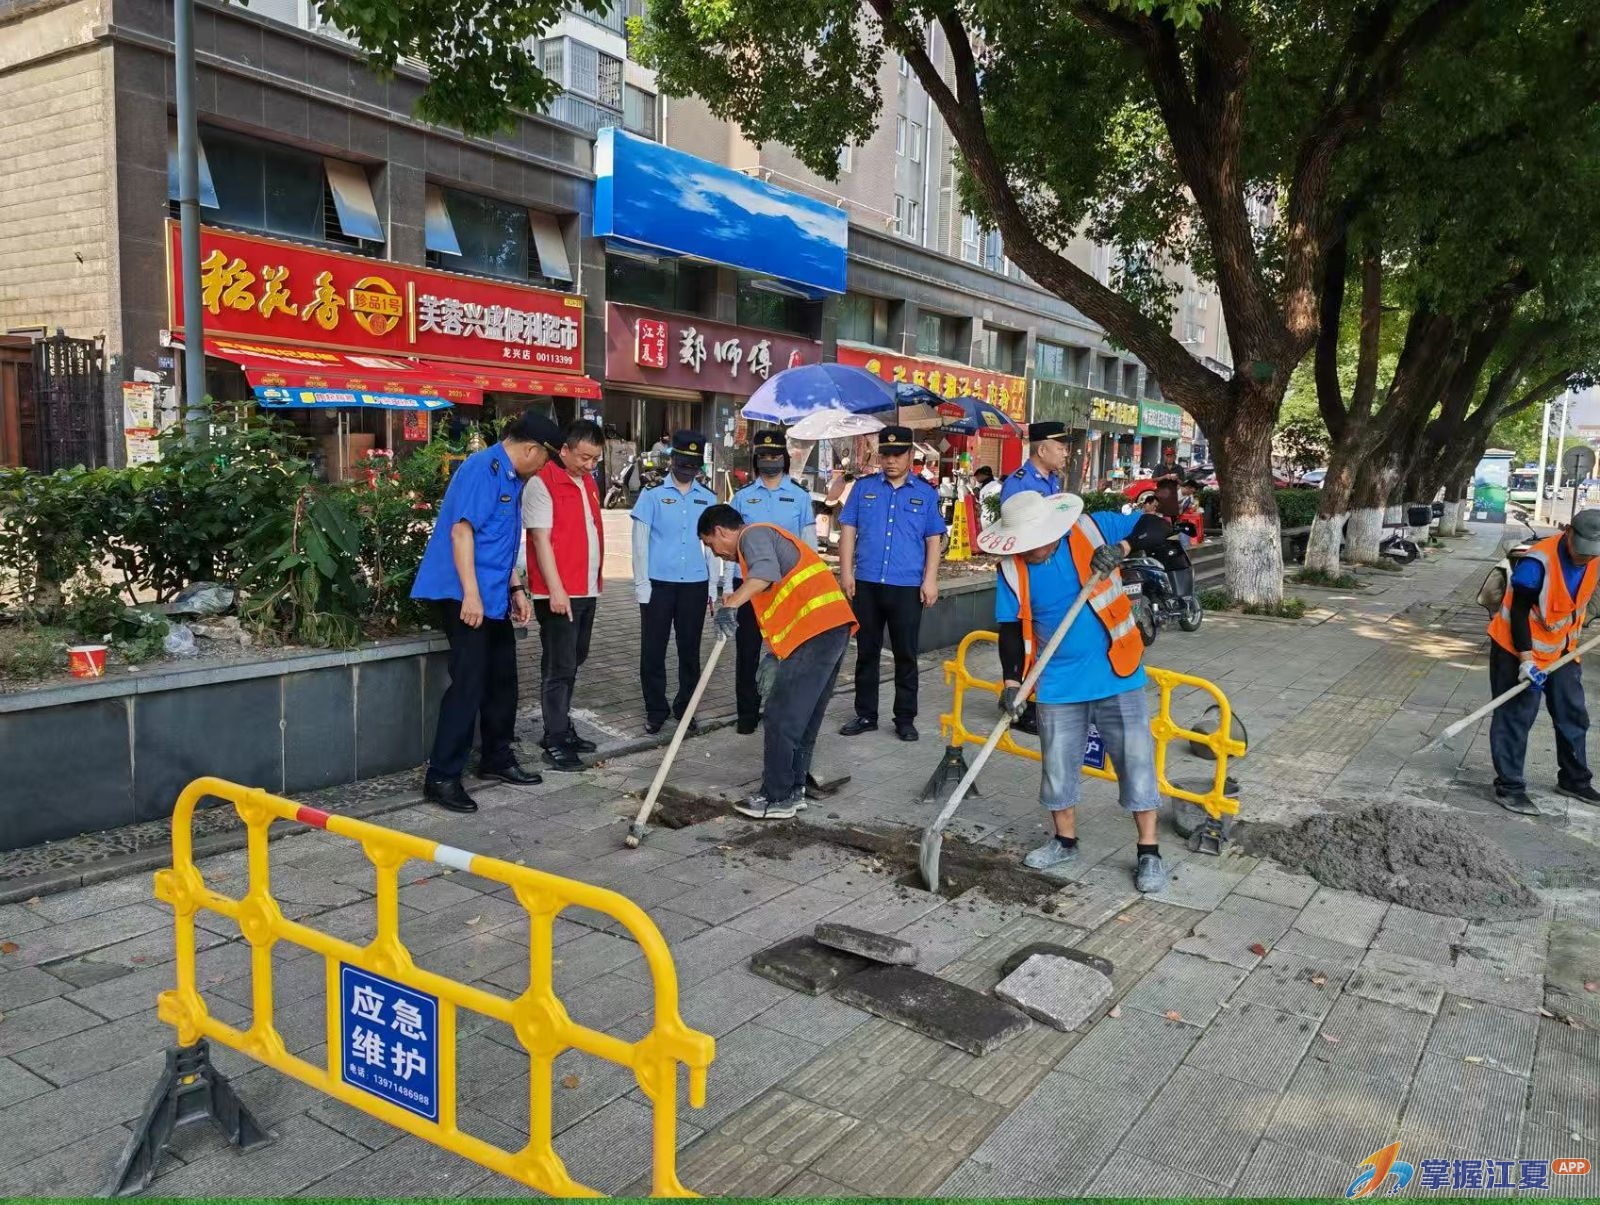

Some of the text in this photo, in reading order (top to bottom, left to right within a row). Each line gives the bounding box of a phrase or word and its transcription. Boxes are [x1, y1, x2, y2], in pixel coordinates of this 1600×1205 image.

[201, 249, 345, 330] 稻花香
[354, 293, 401, 313] 珍品1号
[418, 294, 579, 350] 芙蓉兴盛便利超市
[642, 323, 654, 363] 江夏
[655, 323, 666, 367] 老字号
[503, 347, 573, 365] 龙兴店 00113399
[679, 326, 773, 380] 郑师傅
[350, 985, 428, 1041] 应急
[351, 1024, 427, 1081] 维护
[373, 1074, 430, 1106] 13971486988
